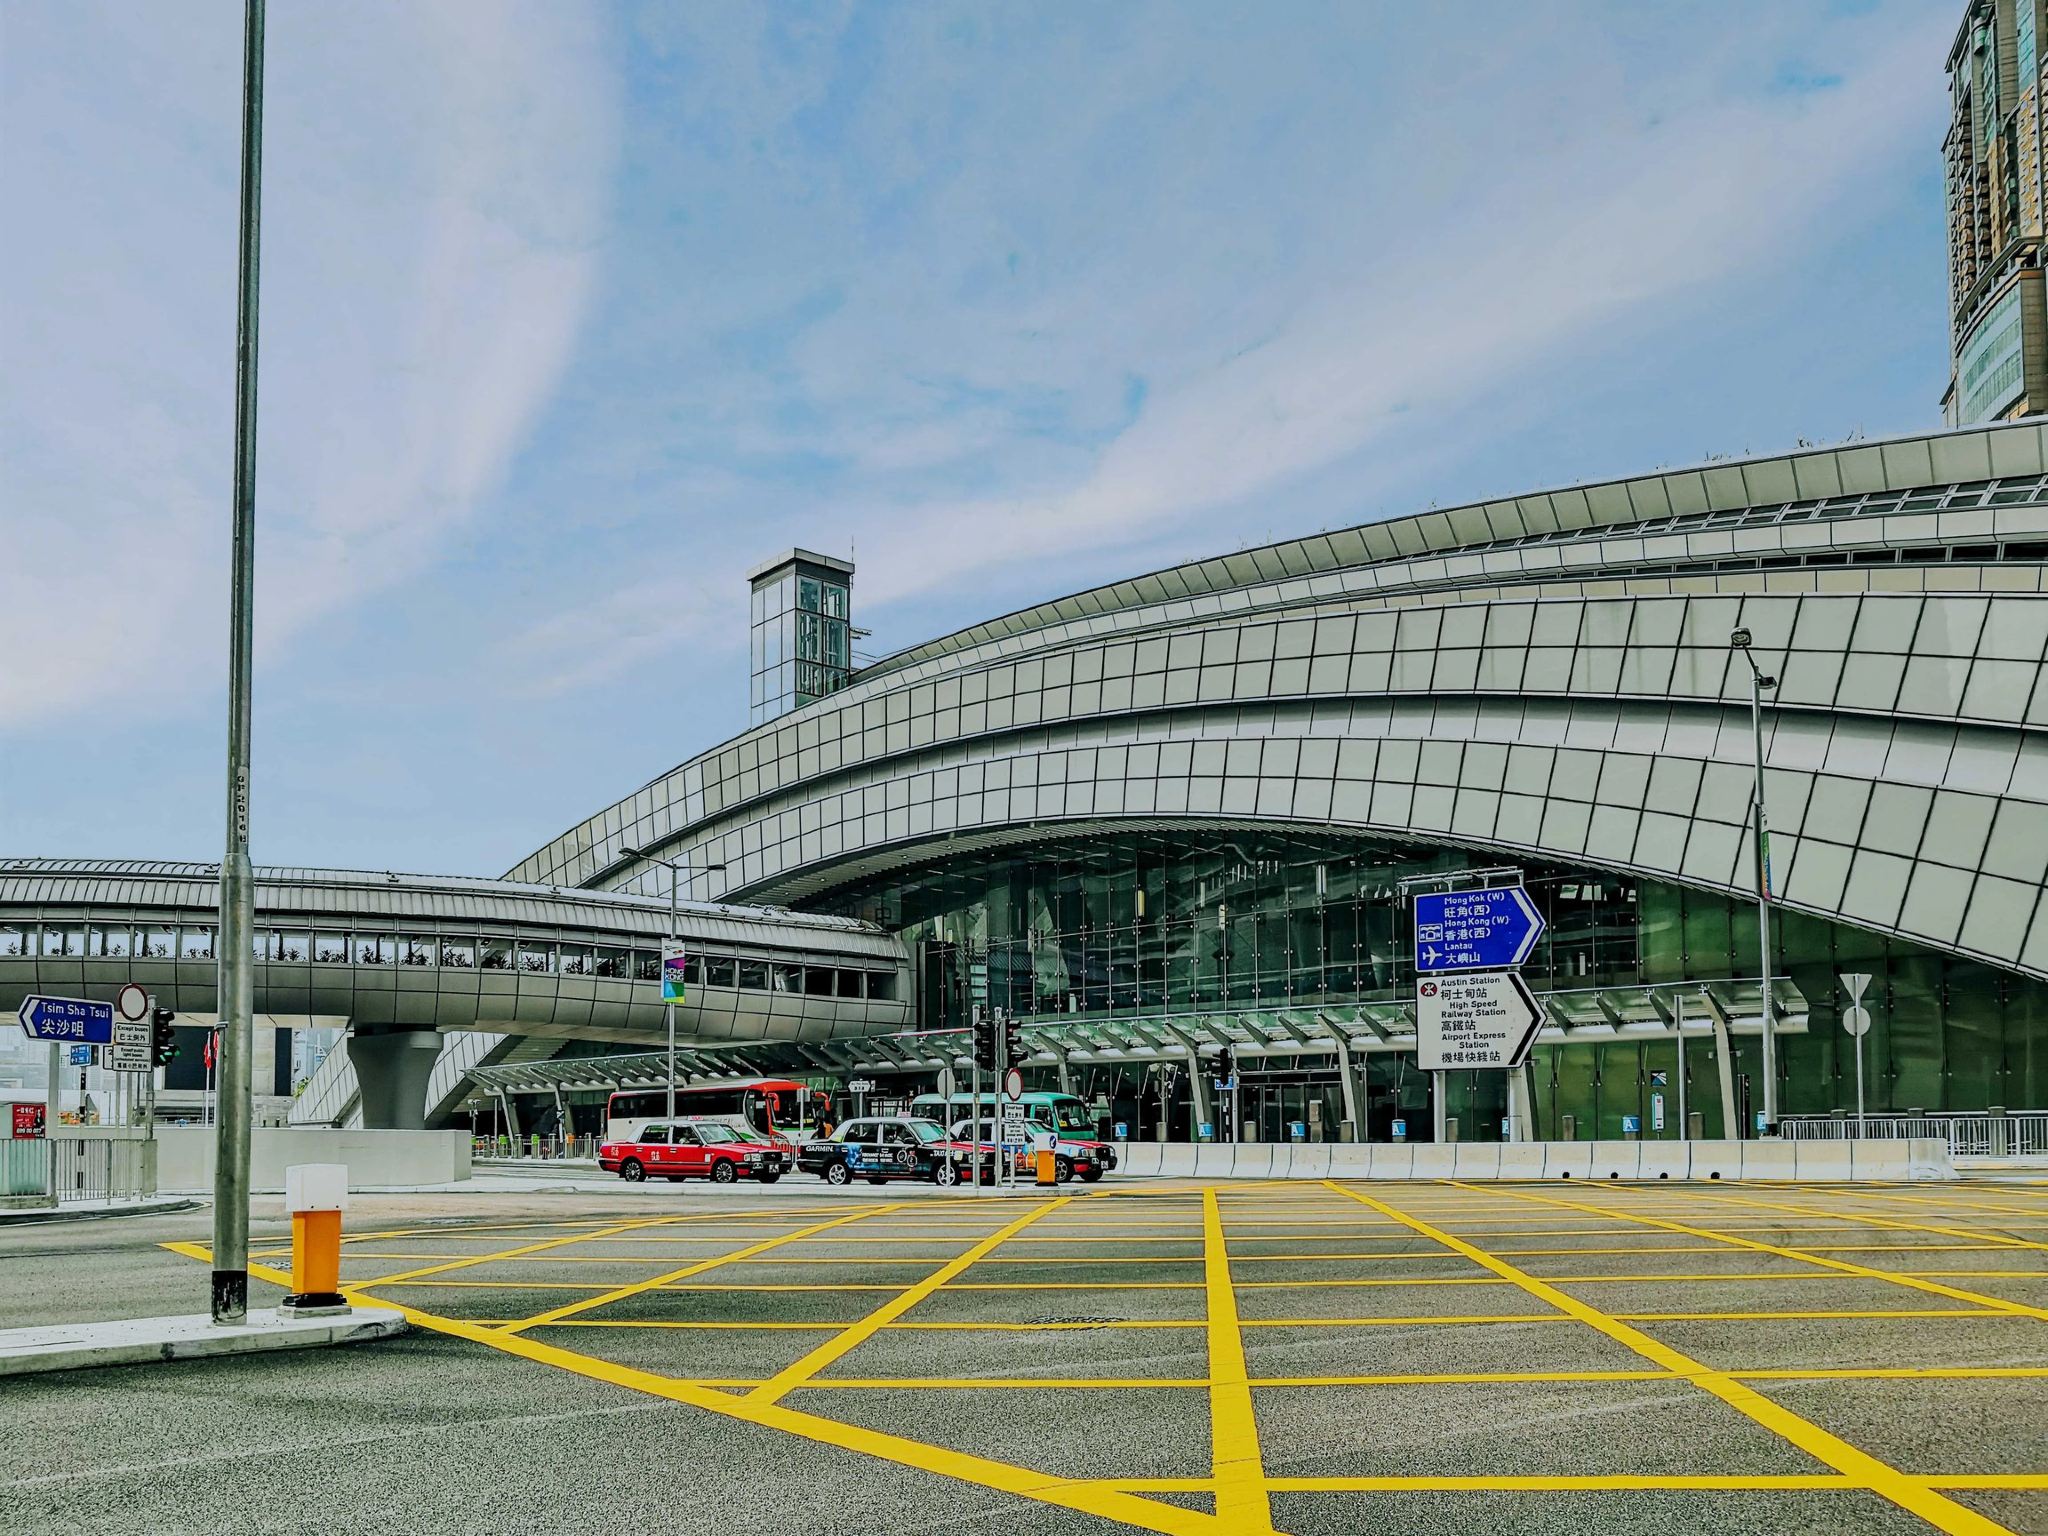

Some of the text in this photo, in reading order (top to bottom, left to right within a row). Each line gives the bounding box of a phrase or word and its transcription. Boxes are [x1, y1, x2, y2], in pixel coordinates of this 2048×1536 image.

[1469, 894, 1485, 902] Kok
[1487, 892, 1505, 902] (W)
[1444, 905, 1490, 918] 旺角(西)
[1468, 918, 1490, 926] Kong
[1492, 916, 1509, 925] (W)
[1445, 928, 1491, 941] 香港(西)
[1446, 952, 1480, 964] 大嶼山
[1441, 978, 1467, 987] Austin
[1441, 988, 1487, 1000] 柯士甸站
[41, 1002, 109, 1018] Tsim Sha Tsui
[41, 1018, 85, 1036] 尖沙咀
